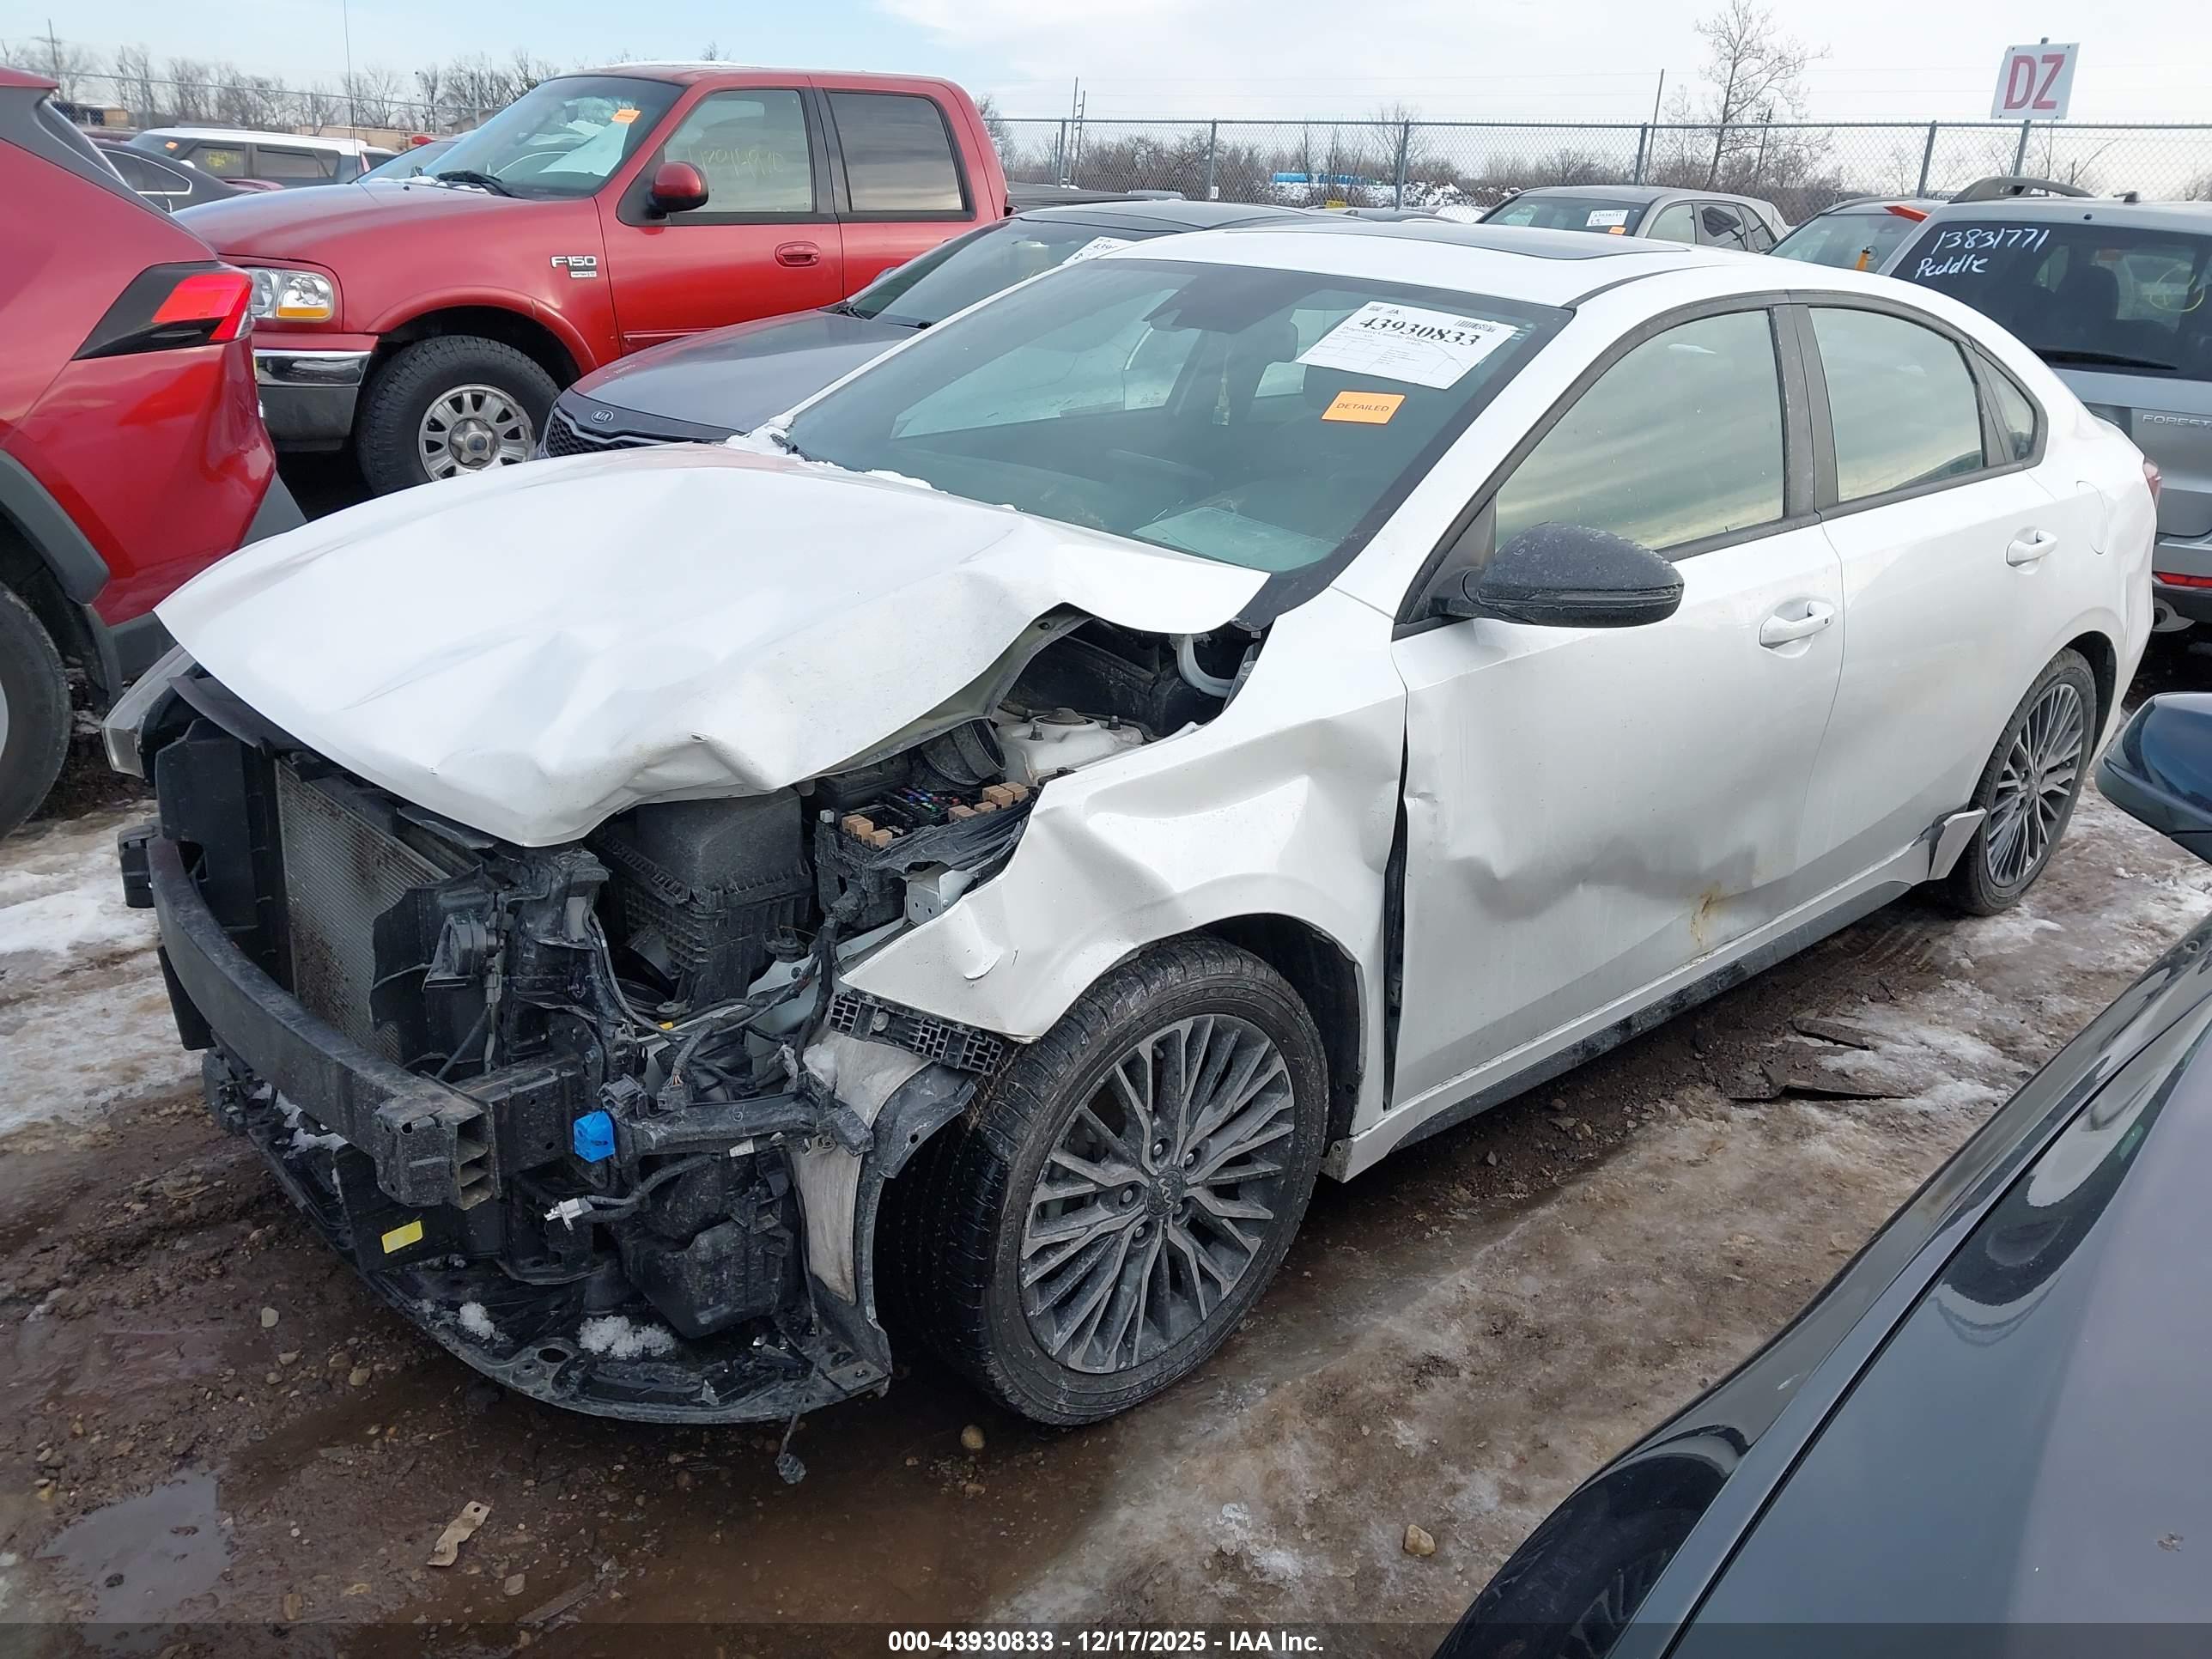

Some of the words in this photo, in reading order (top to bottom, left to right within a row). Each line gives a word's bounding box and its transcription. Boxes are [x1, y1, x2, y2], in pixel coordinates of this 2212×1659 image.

[2003, 53, 2066, 110] DZ
[1931, 228, 2050, 255] 13831771
[1359, 317, 1481, 346] 43930833
[1336, 401, 1389, 413] DETAILED
